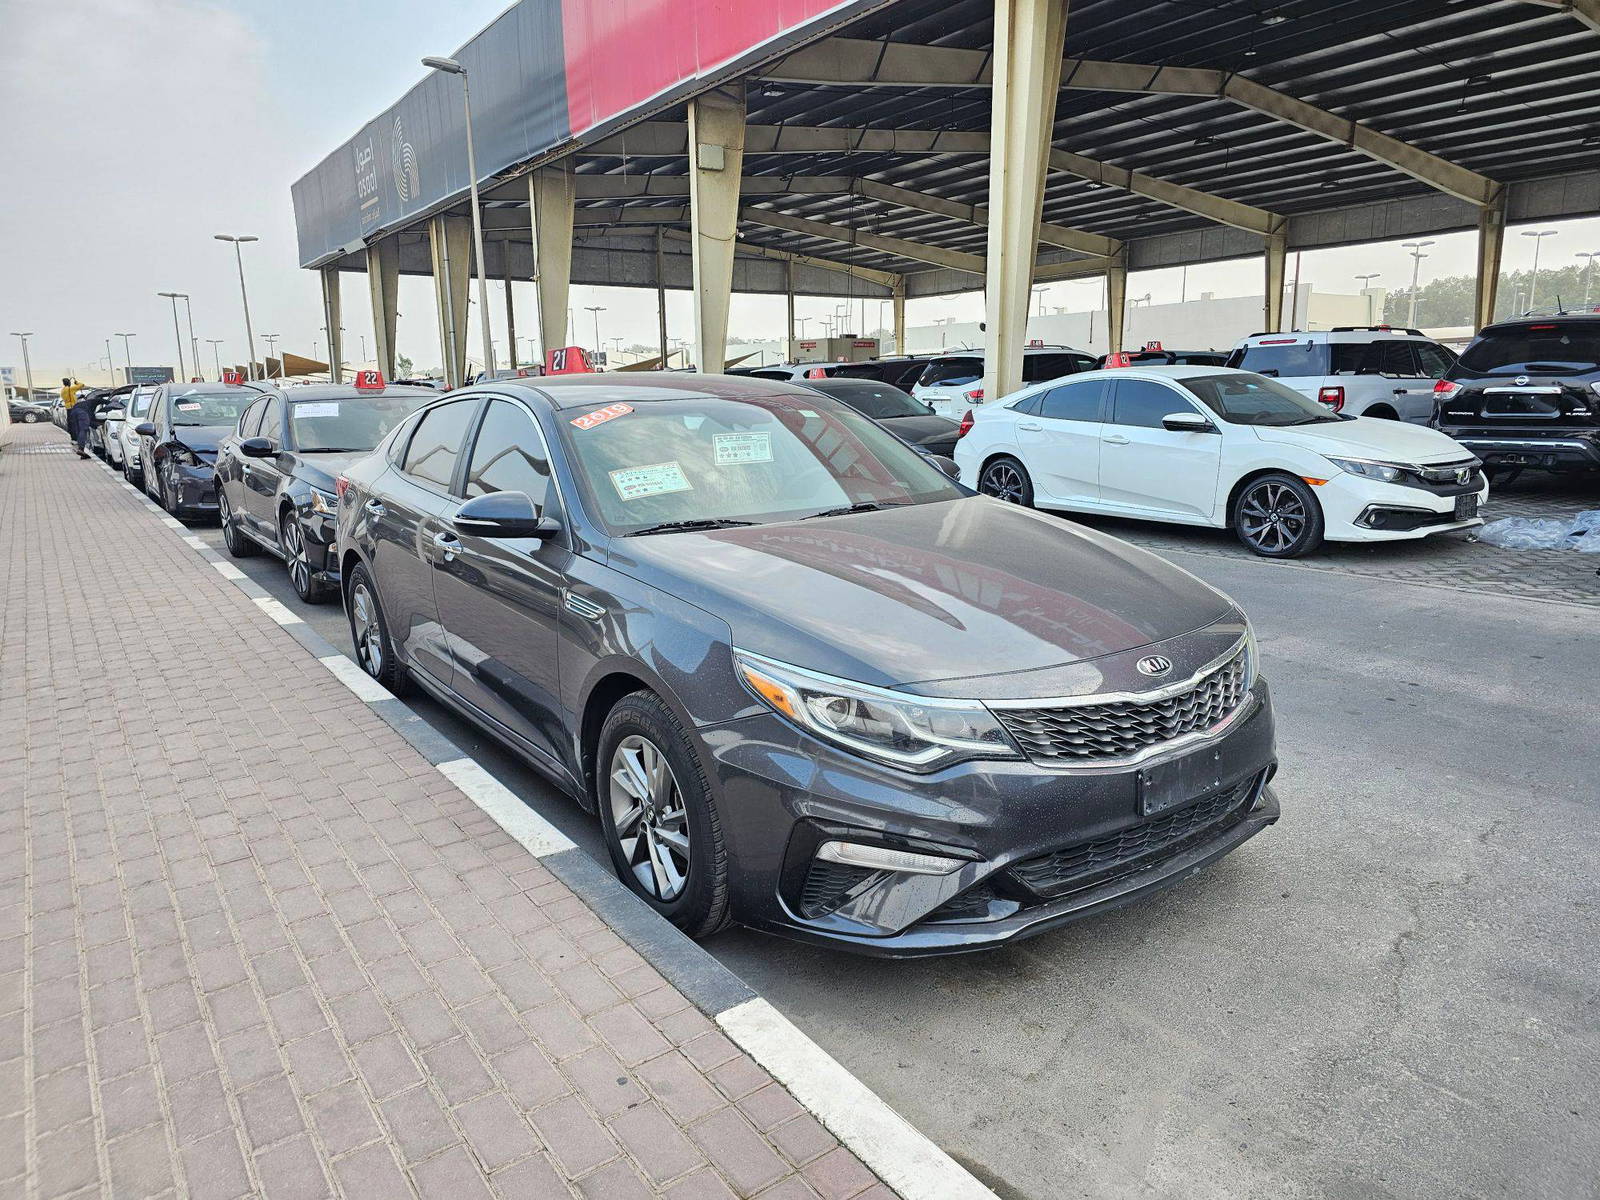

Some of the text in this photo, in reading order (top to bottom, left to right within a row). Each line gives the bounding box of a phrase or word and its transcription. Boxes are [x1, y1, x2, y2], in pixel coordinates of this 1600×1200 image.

[552, 350, 566, 371] 21
[228, 373, 236, 381] 17
[364, 372, 378, 384] 22
[576, 403, 630, 426] 2019
[1140, 655, 1171, 673] KIA
